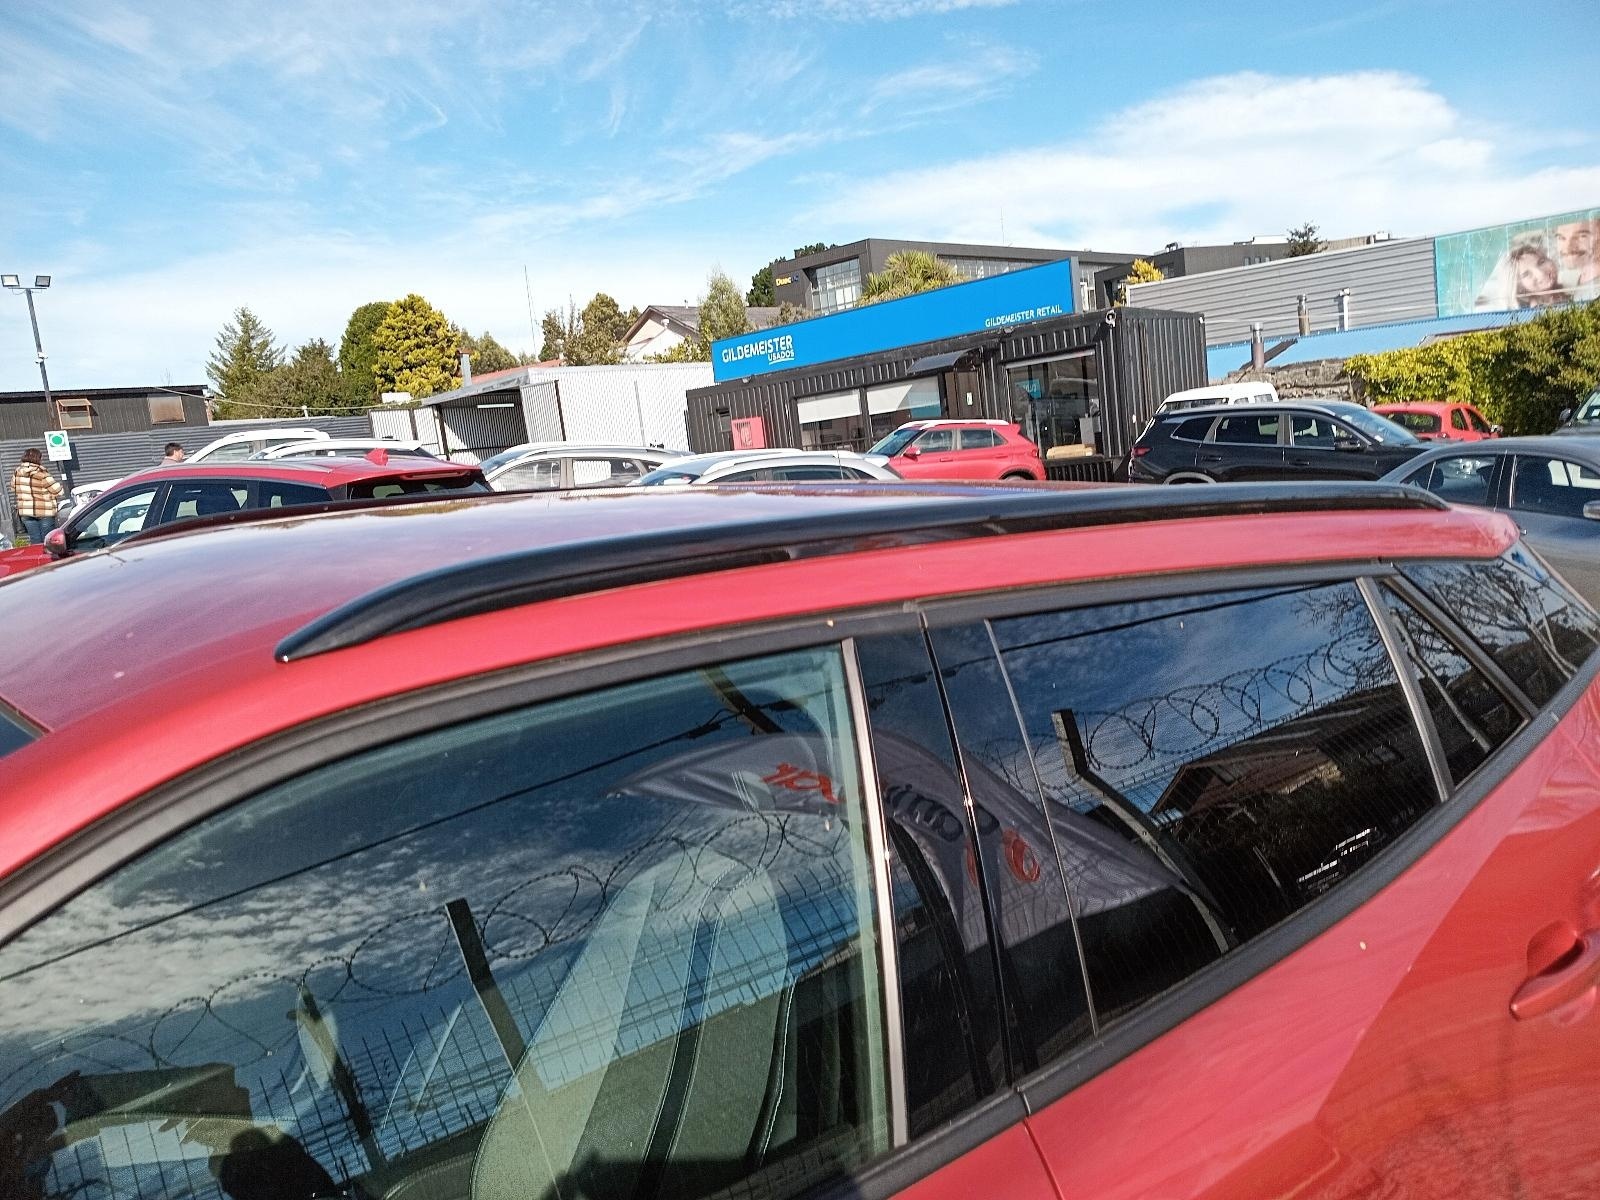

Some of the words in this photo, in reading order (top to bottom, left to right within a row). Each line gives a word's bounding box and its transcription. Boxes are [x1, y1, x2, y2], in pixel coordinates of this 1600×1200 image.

[985, 309, 1035, 328] GILDEMEISTER
[1036, 304, 1063, 318] RETAIL
[721, 334, 793, 363] GILDEMEISTER
[767, 349, 795, 362] USADOS
